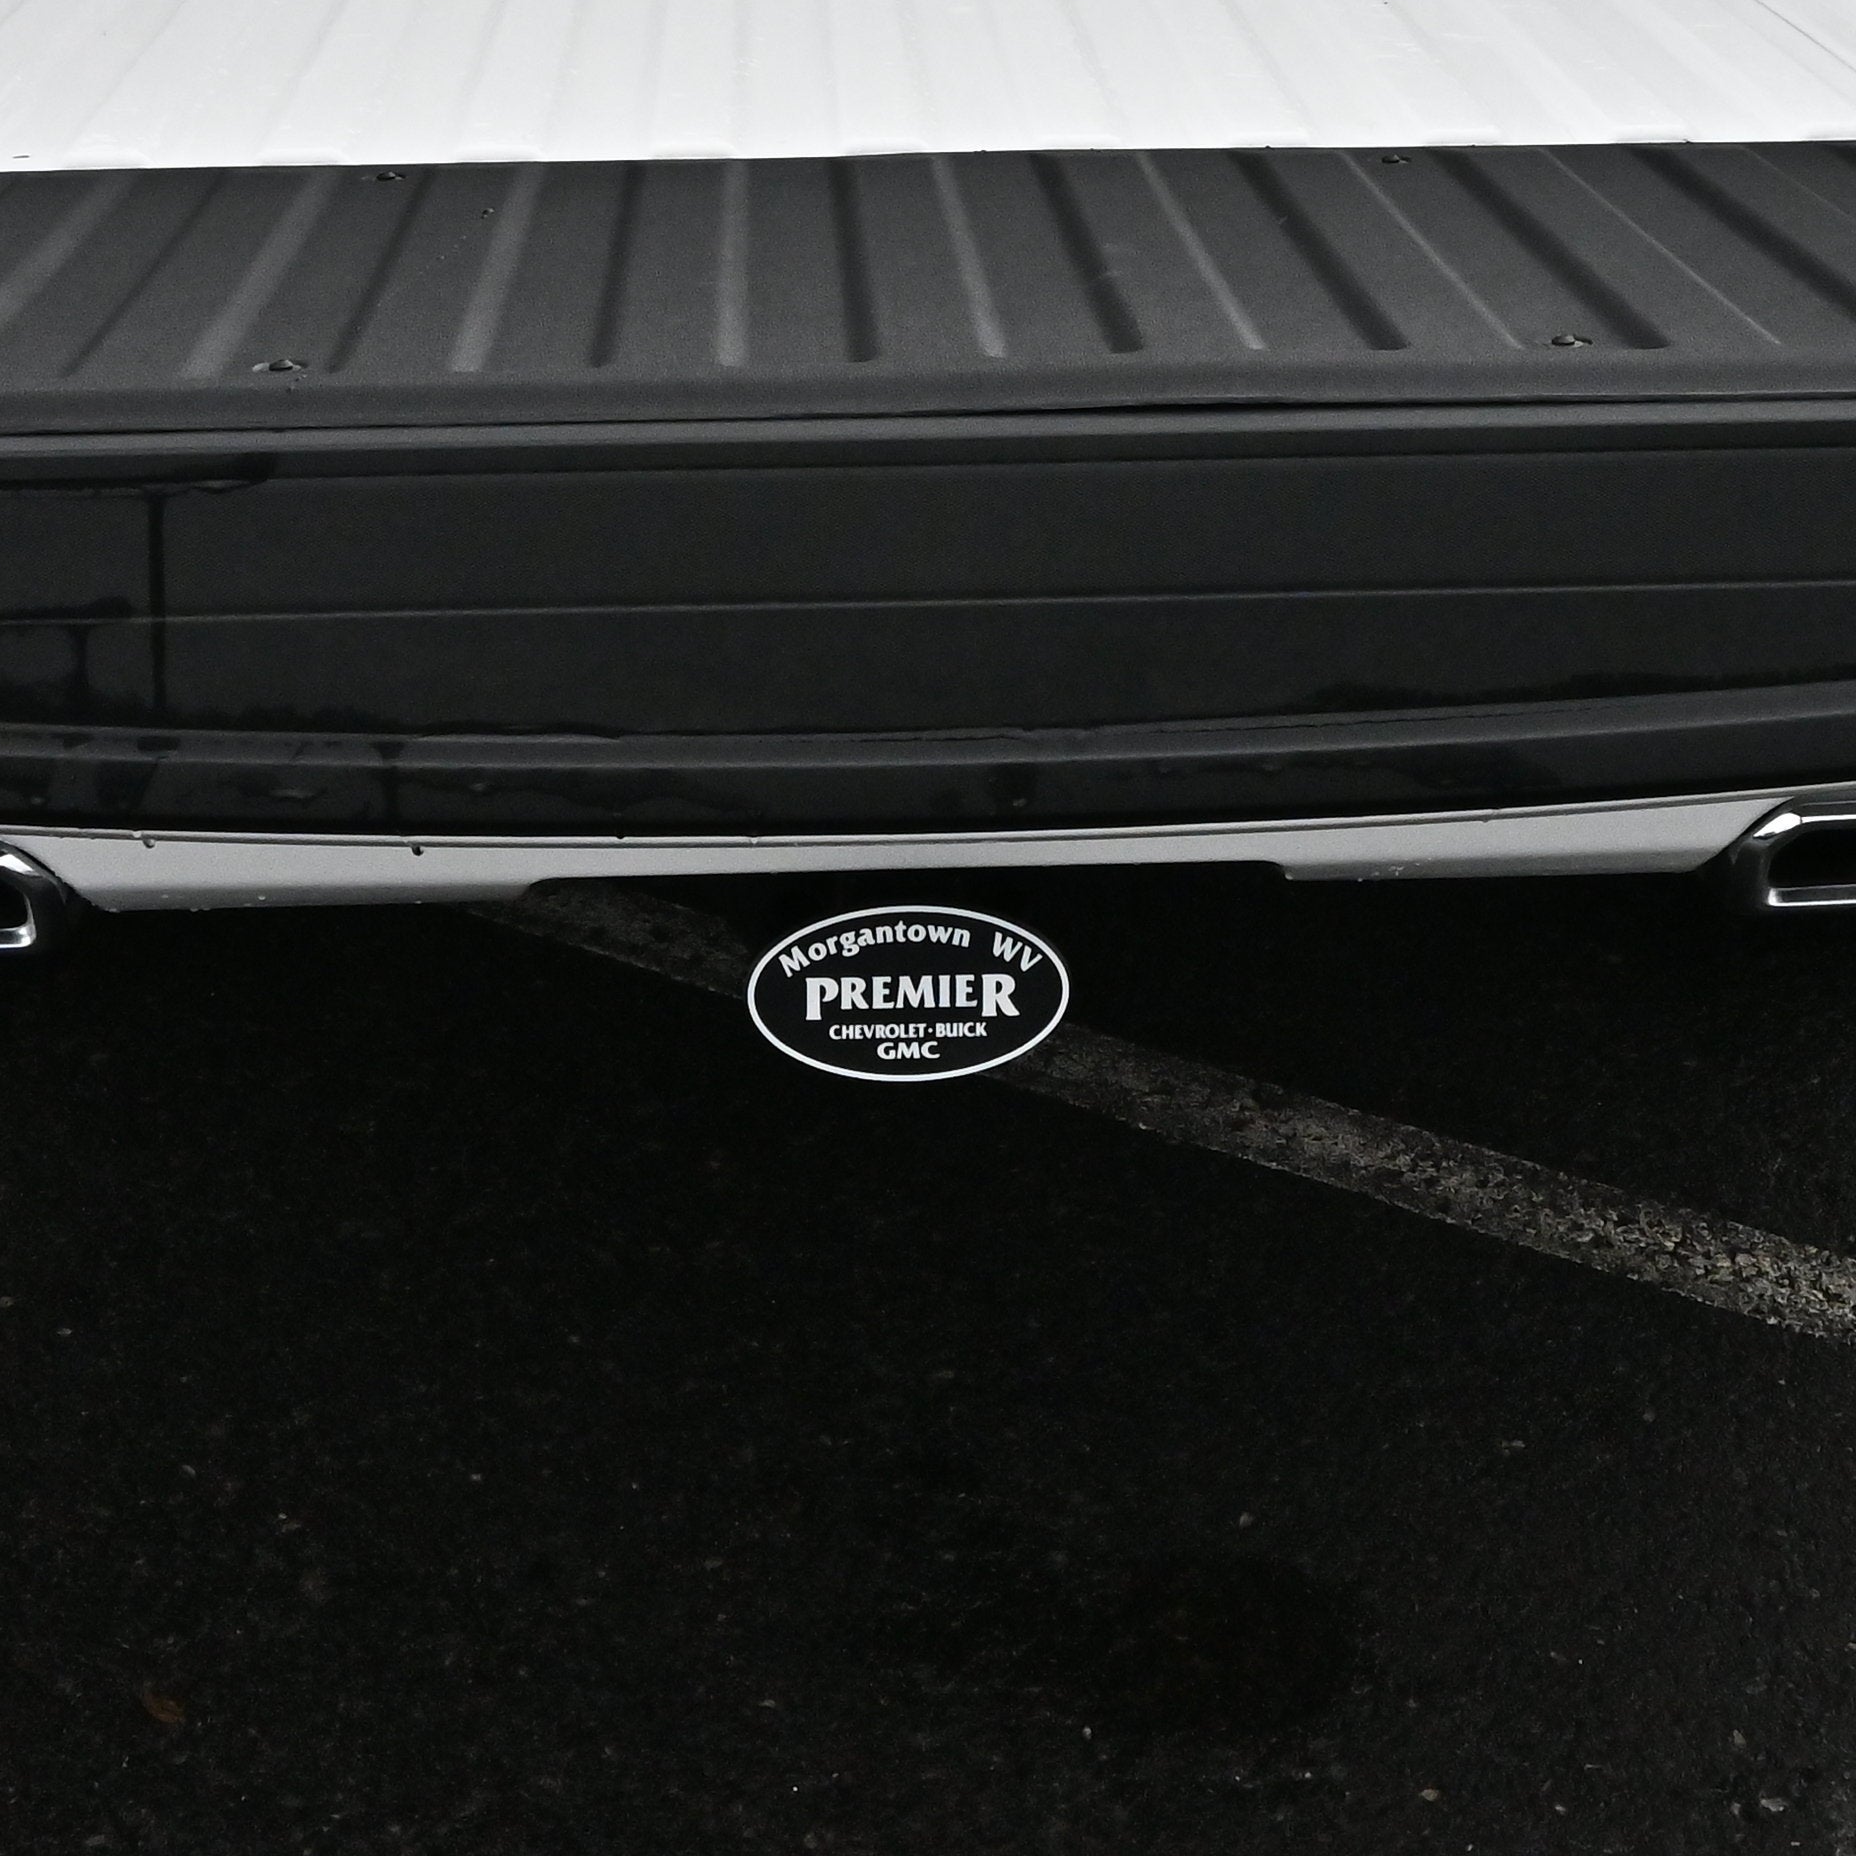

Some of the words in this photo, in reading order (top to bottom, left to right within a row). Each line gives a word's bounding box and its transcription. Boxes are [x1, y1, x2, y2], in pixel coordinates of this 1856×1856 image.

[778, 920, 971, 978] Morgantown
[992, 930, 1044, 973] WV
[805, 973, 1020, 1021] PREMIER
[876, 1041, 941, 1060] GMC
